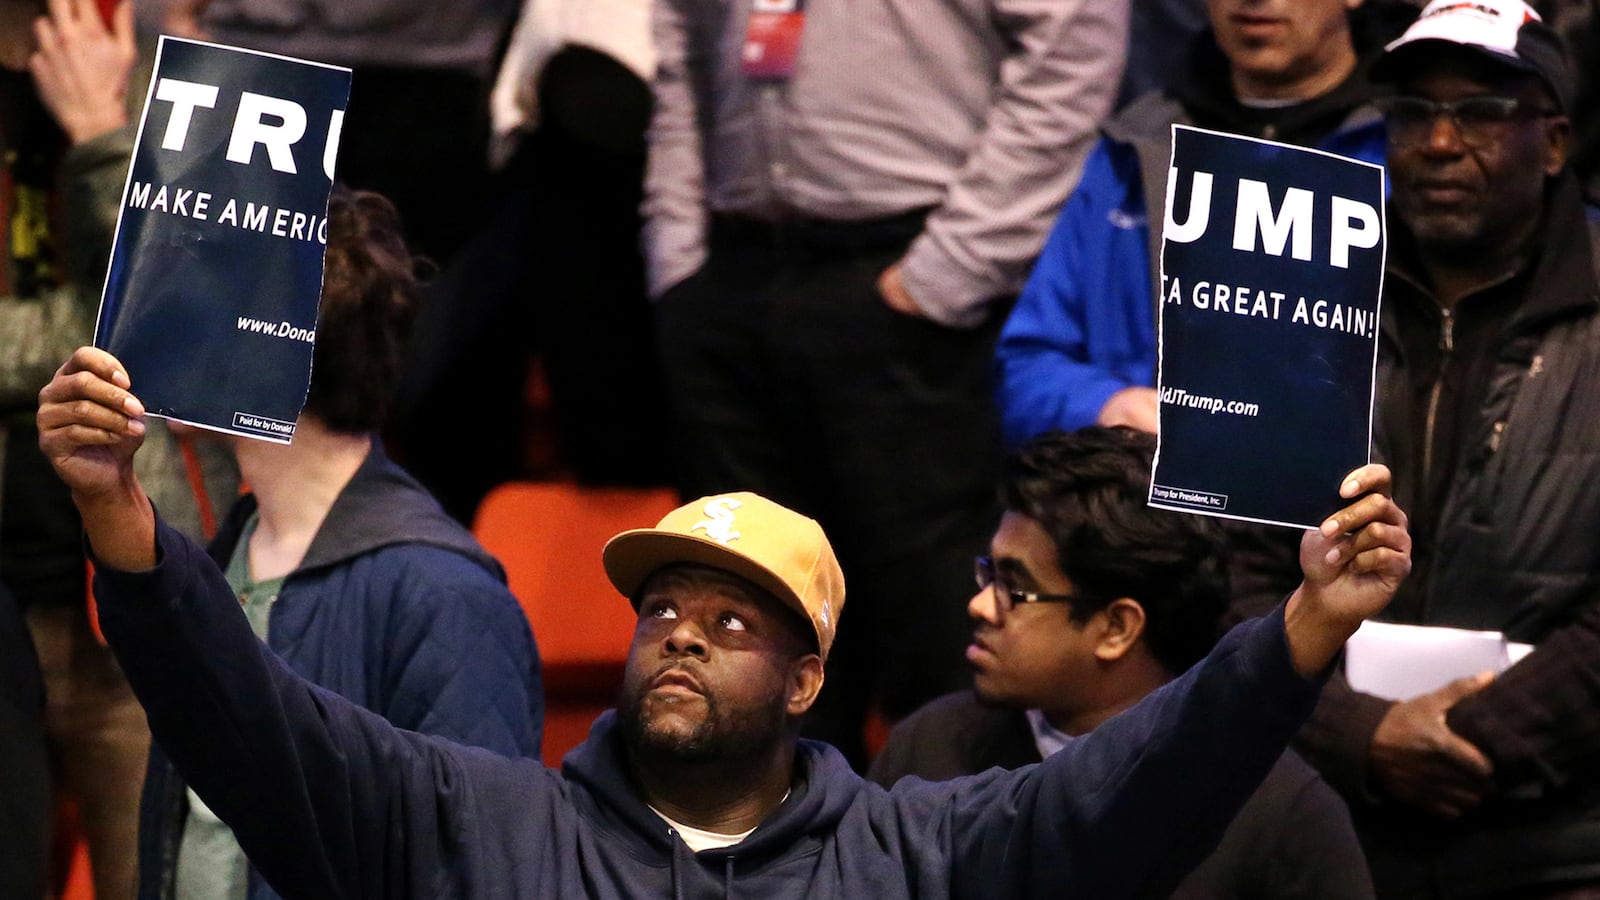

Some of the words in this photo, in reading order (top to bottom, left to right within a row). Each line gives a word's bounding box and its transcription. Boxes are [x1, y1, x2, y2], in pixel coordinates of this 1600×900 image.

[130, 181, 212, 221] MAKE
[1164, 166, 1380, 268] UMP
[1192, 281, 1286, 320] GREAT
[1292, 295, 1374, 338] AGAIN!
[239, 416, 253, 426] Paid
[253, 418, 262, 428] for
[263, 420, 271, 430] by
[271, 422, 292, 433] Donald
[1154, 487, 1169, 499] Trump
[1170, 489, 1178, 499] for
[1179, 491, 1209, 505] President,
[1210, 497, 1220, 505] Inc.
